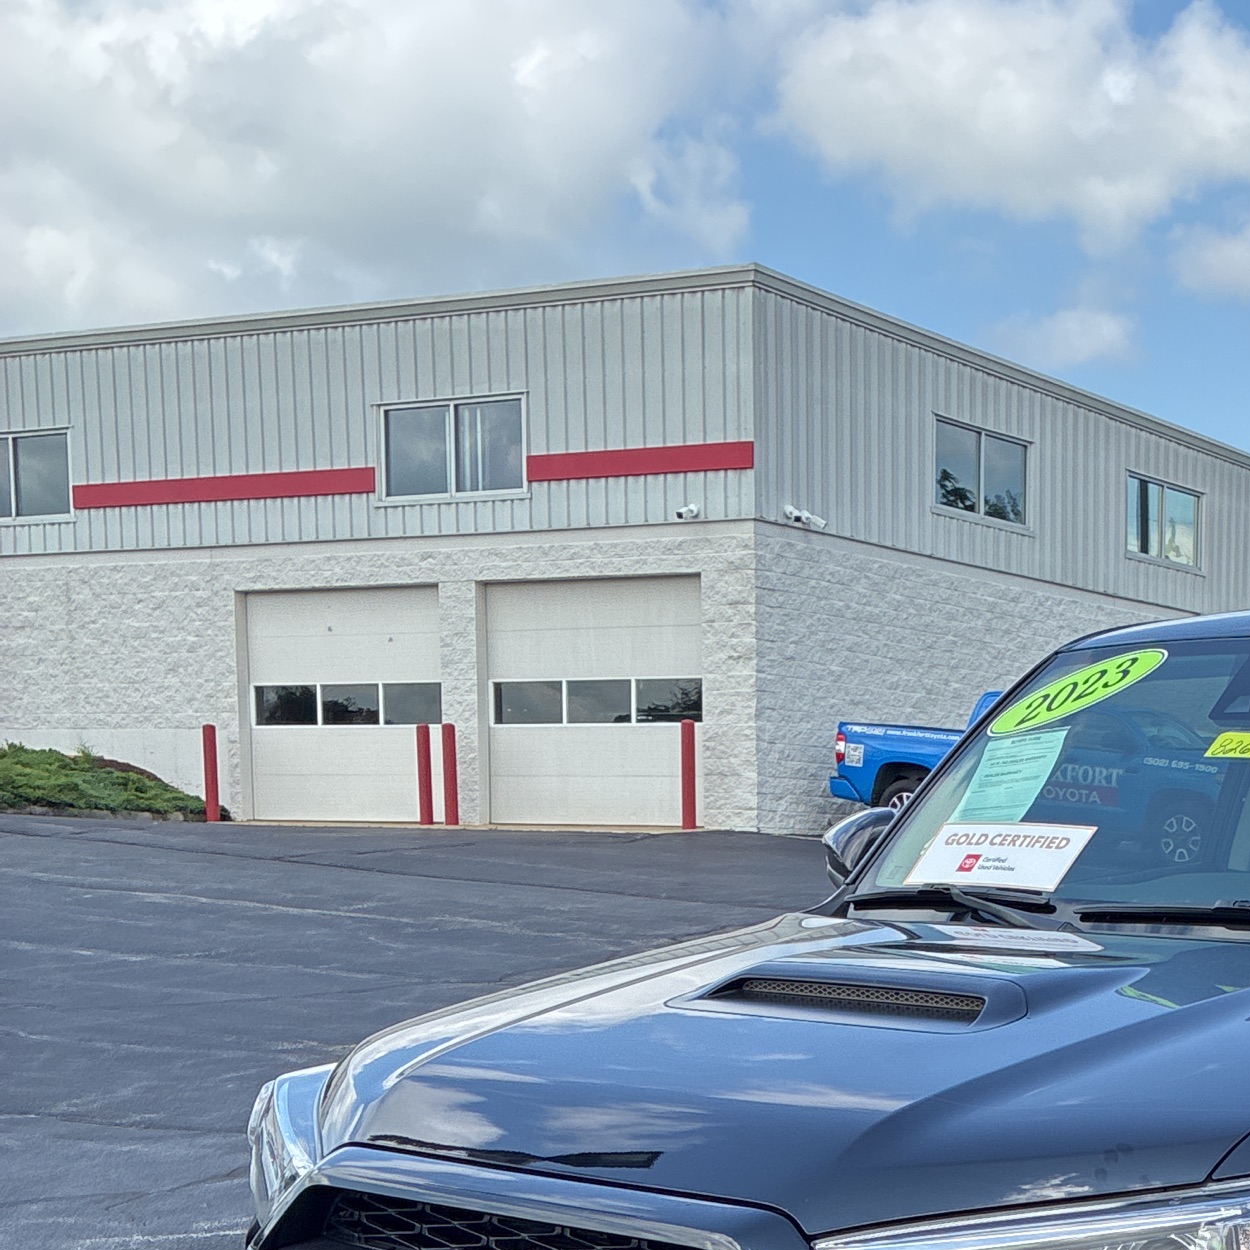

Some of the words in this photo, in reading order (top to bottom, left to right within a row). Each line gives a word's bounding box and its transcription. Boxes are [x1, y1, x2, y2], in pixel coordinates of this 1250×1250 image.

[1013, 656, 1140, 728] 2023
[1043, 785, 1102, 804] OYOTA
[944, 833, 989, 846] GOLD
[988, 833, 1071, 850] CERTIFIED
[982, 856, 1008, 864] Certified
